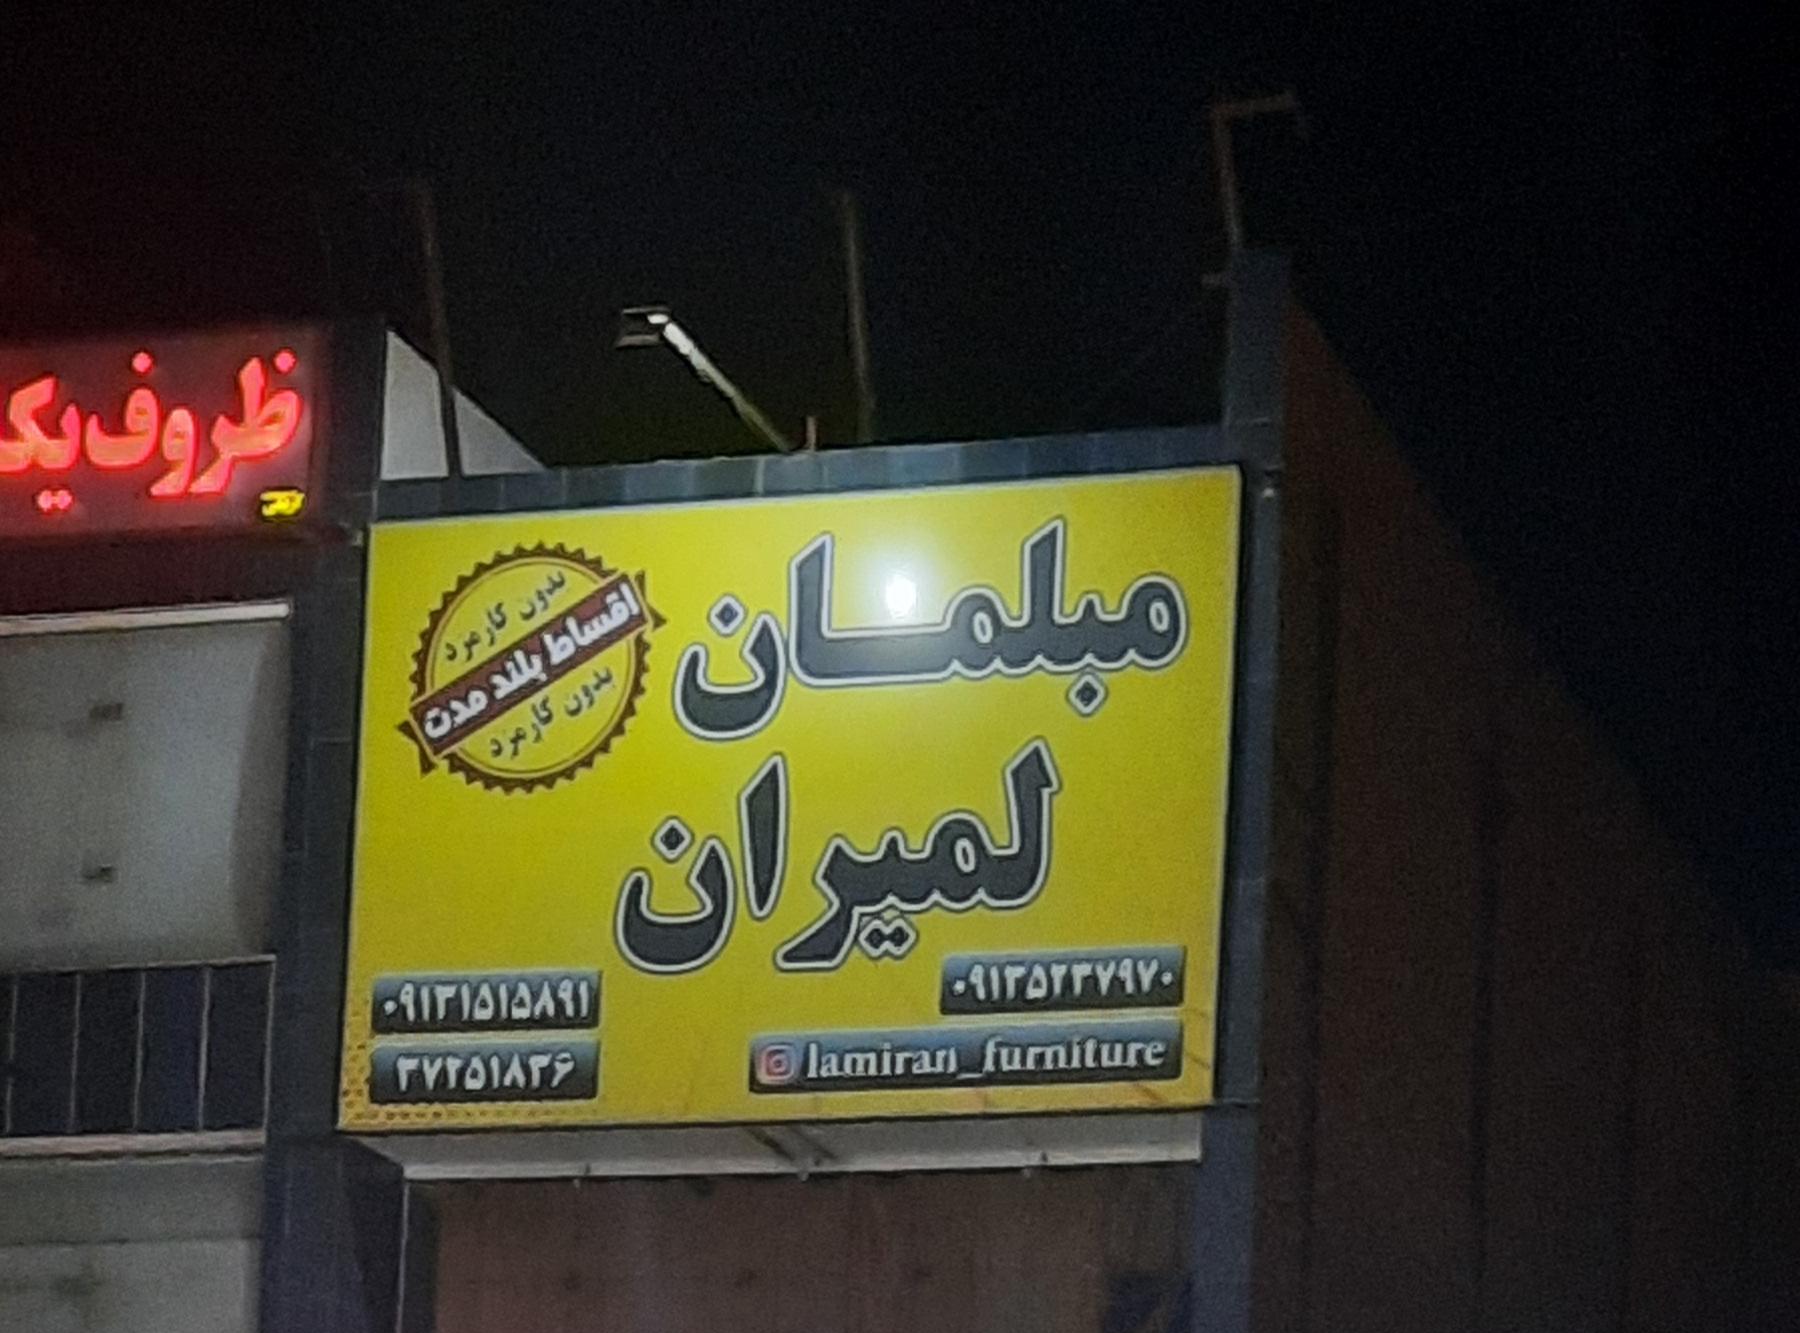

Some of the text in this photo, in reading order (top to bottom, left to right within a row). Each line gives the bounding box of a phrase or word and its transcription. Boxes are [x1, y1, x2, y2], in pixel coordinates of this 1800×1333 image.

[84, 349, 304, 498] ظروف
[519, 570, 566, 621] بدون
[672, 515, 1188, 739] مبلمان
[424, 581, 641, 738] اقساط بلند مدت
[564, 666, 614, 718] بدون
[613, 737, 1062, 973] لمیران
[384, 977, 590, 1022] ۰۹۱۳۱۵۱۵۸۹۱
[806, 1036, 1167, 1081] lamiran_furniture
